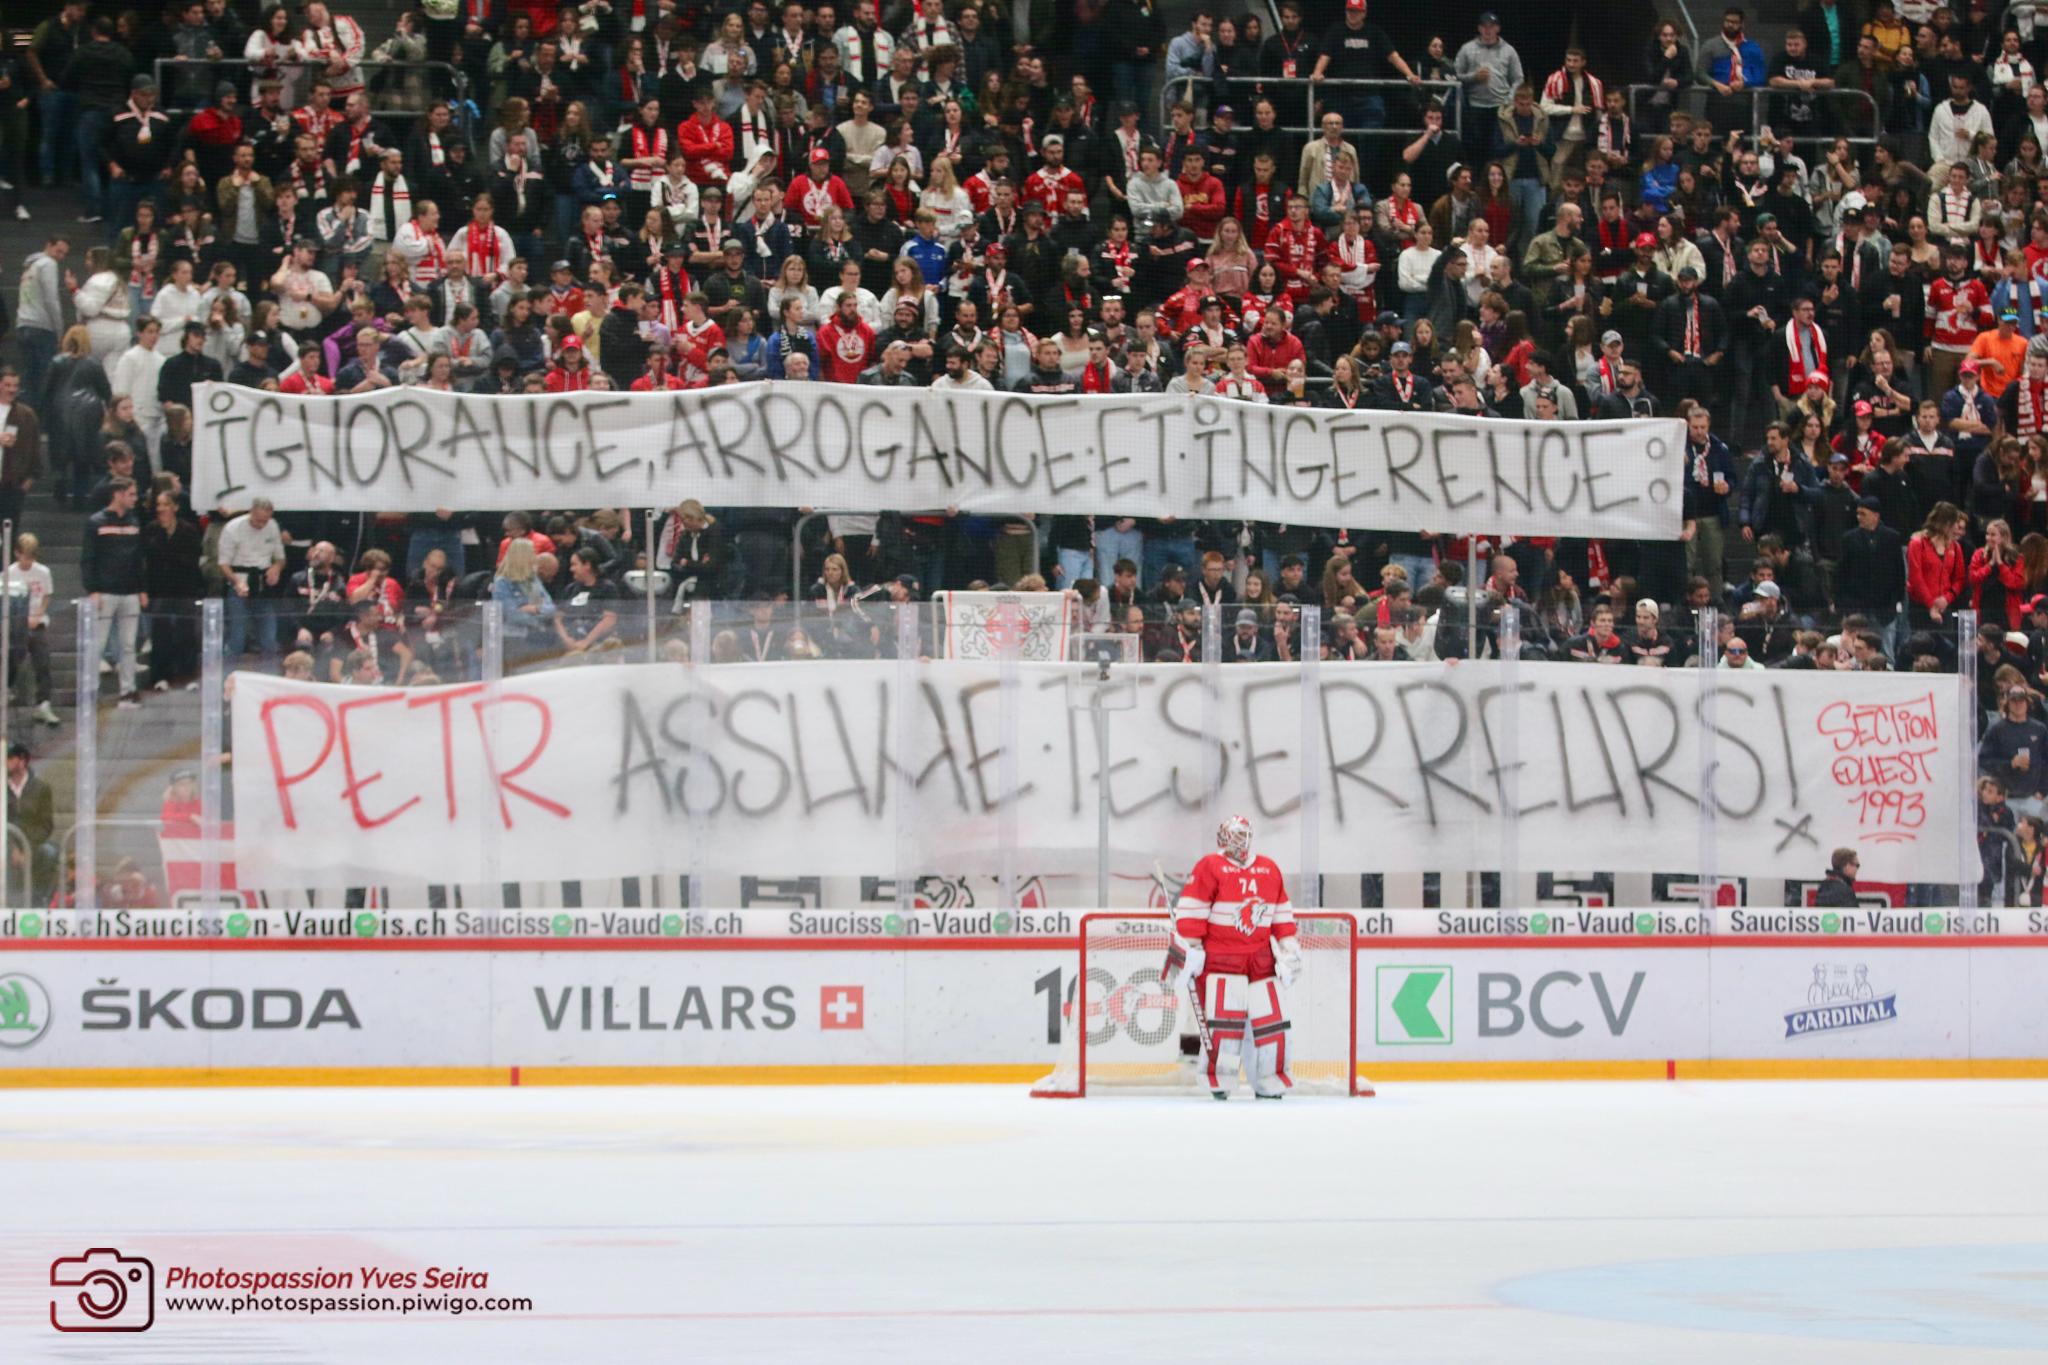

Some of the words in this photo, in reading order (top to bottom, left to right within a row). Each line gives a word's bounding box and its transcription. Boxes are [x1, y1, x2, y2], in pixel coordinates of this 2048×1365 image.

[664, 392, 1088, 495] ARROGANCE
[1099, 405, 1183, 497] ET
[259, 682, 571, 831] PETR
[609, 677, 1035, 817] ASSUME
[1040, 676, 1232, 822] TES
[1241, 680, 1820, 854] ERREURS!
[1848, 790, 1926, 828] 1993
[1239, 878, 1258, 895] 74
[81, 977, 362, 1030] ŠKODA
[534, 985, 797, 1031] VILLARS
[1477, 971, 1646, 1038] BCV
[1791, 1000, 1891, 1033] CARDINAL
